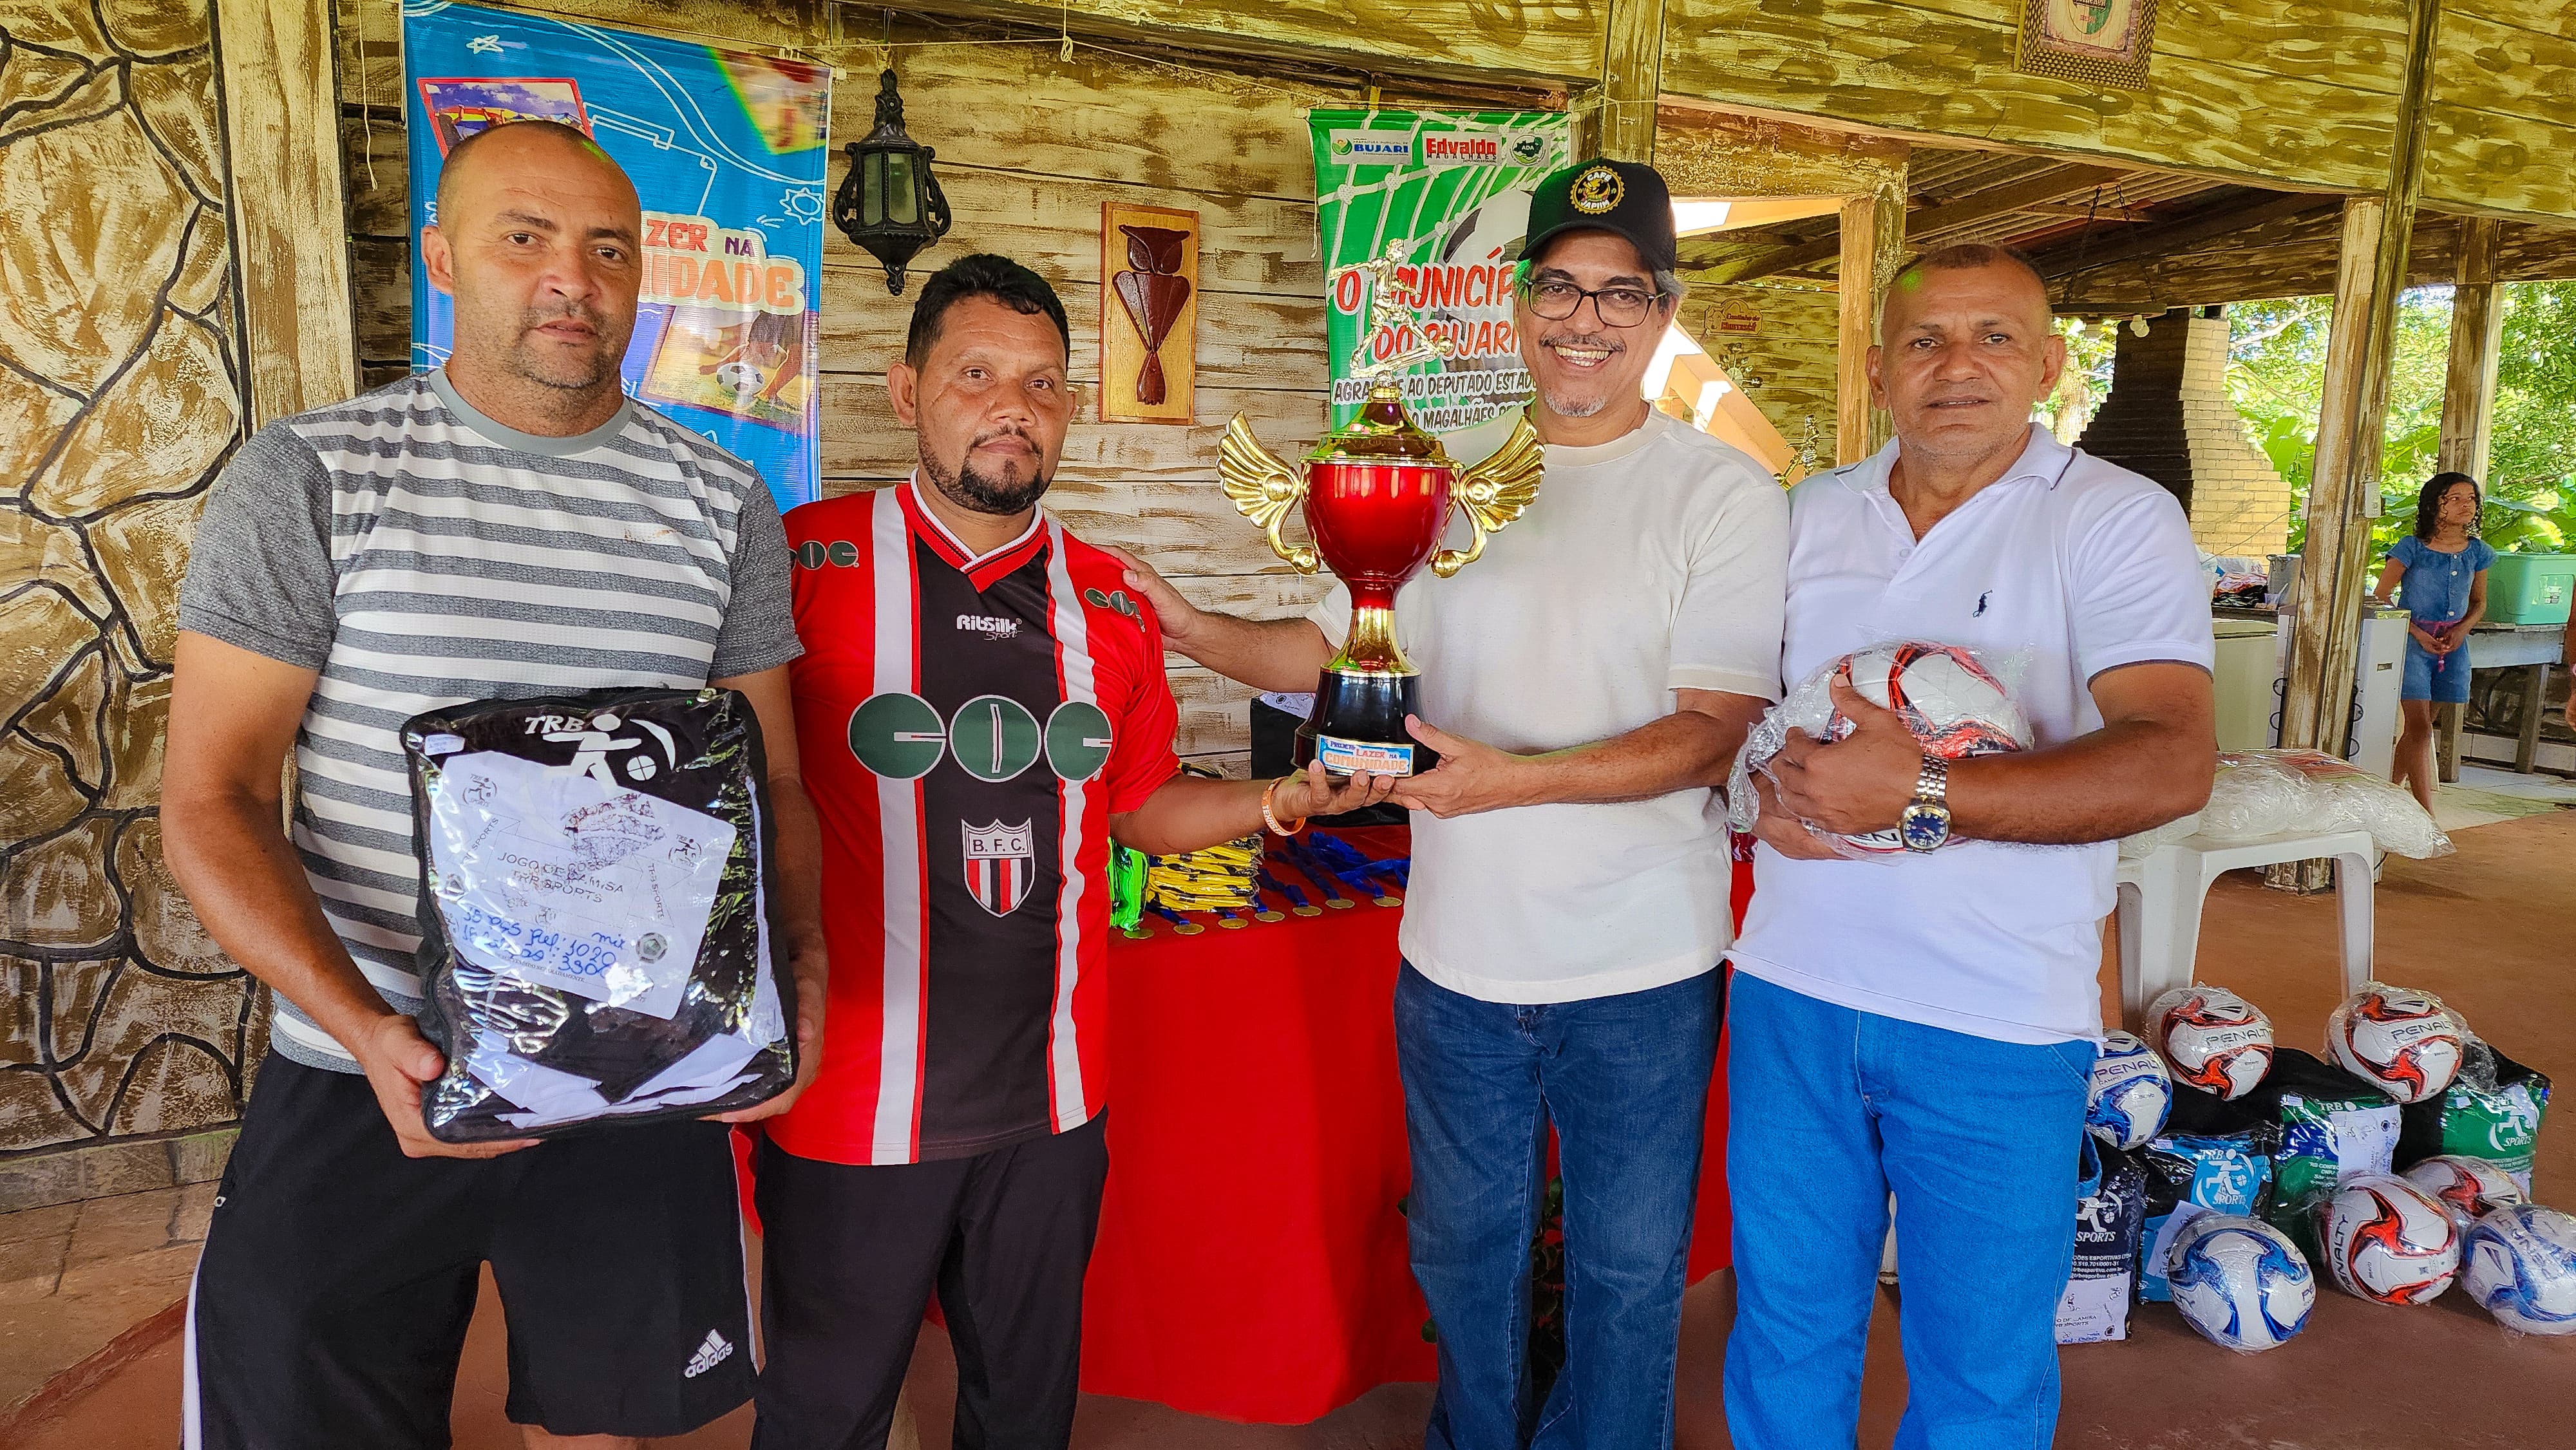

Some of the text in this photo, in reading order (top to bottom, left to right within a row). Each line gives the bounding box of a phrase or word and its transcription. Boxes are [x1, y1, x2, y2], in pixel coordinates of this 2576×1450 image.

[1354, 144, 1408, 153] BUJARI
[1426, 138, 1497, 155] Edvaldo
[725, 236, 755, 258] NA
[1336, 270, 1361, 312] O
[1374, 323, 1413, 361] DO
[1407, 377, 1424, 397] AO
[1428, 373, 1492, 395] DEPUTADO
[956, 614, 1017, 633] RibSilk
[524, 715, 585, 735] TRB
[1356, 748, 1385, 758] LAZER
[471, 817, 499, 851] SPORTS
[497, 852, 538, 871] JOGO
[2318, 1102, 2344, 1111] TRB
[2504, 1136, 2533, 1147] SPORTS
[2199, 1148, 2224, 1160] TRB
[2076, 1230, 2116, 1243] SPORTS
[685, 1341, 734, 1379] adidas
